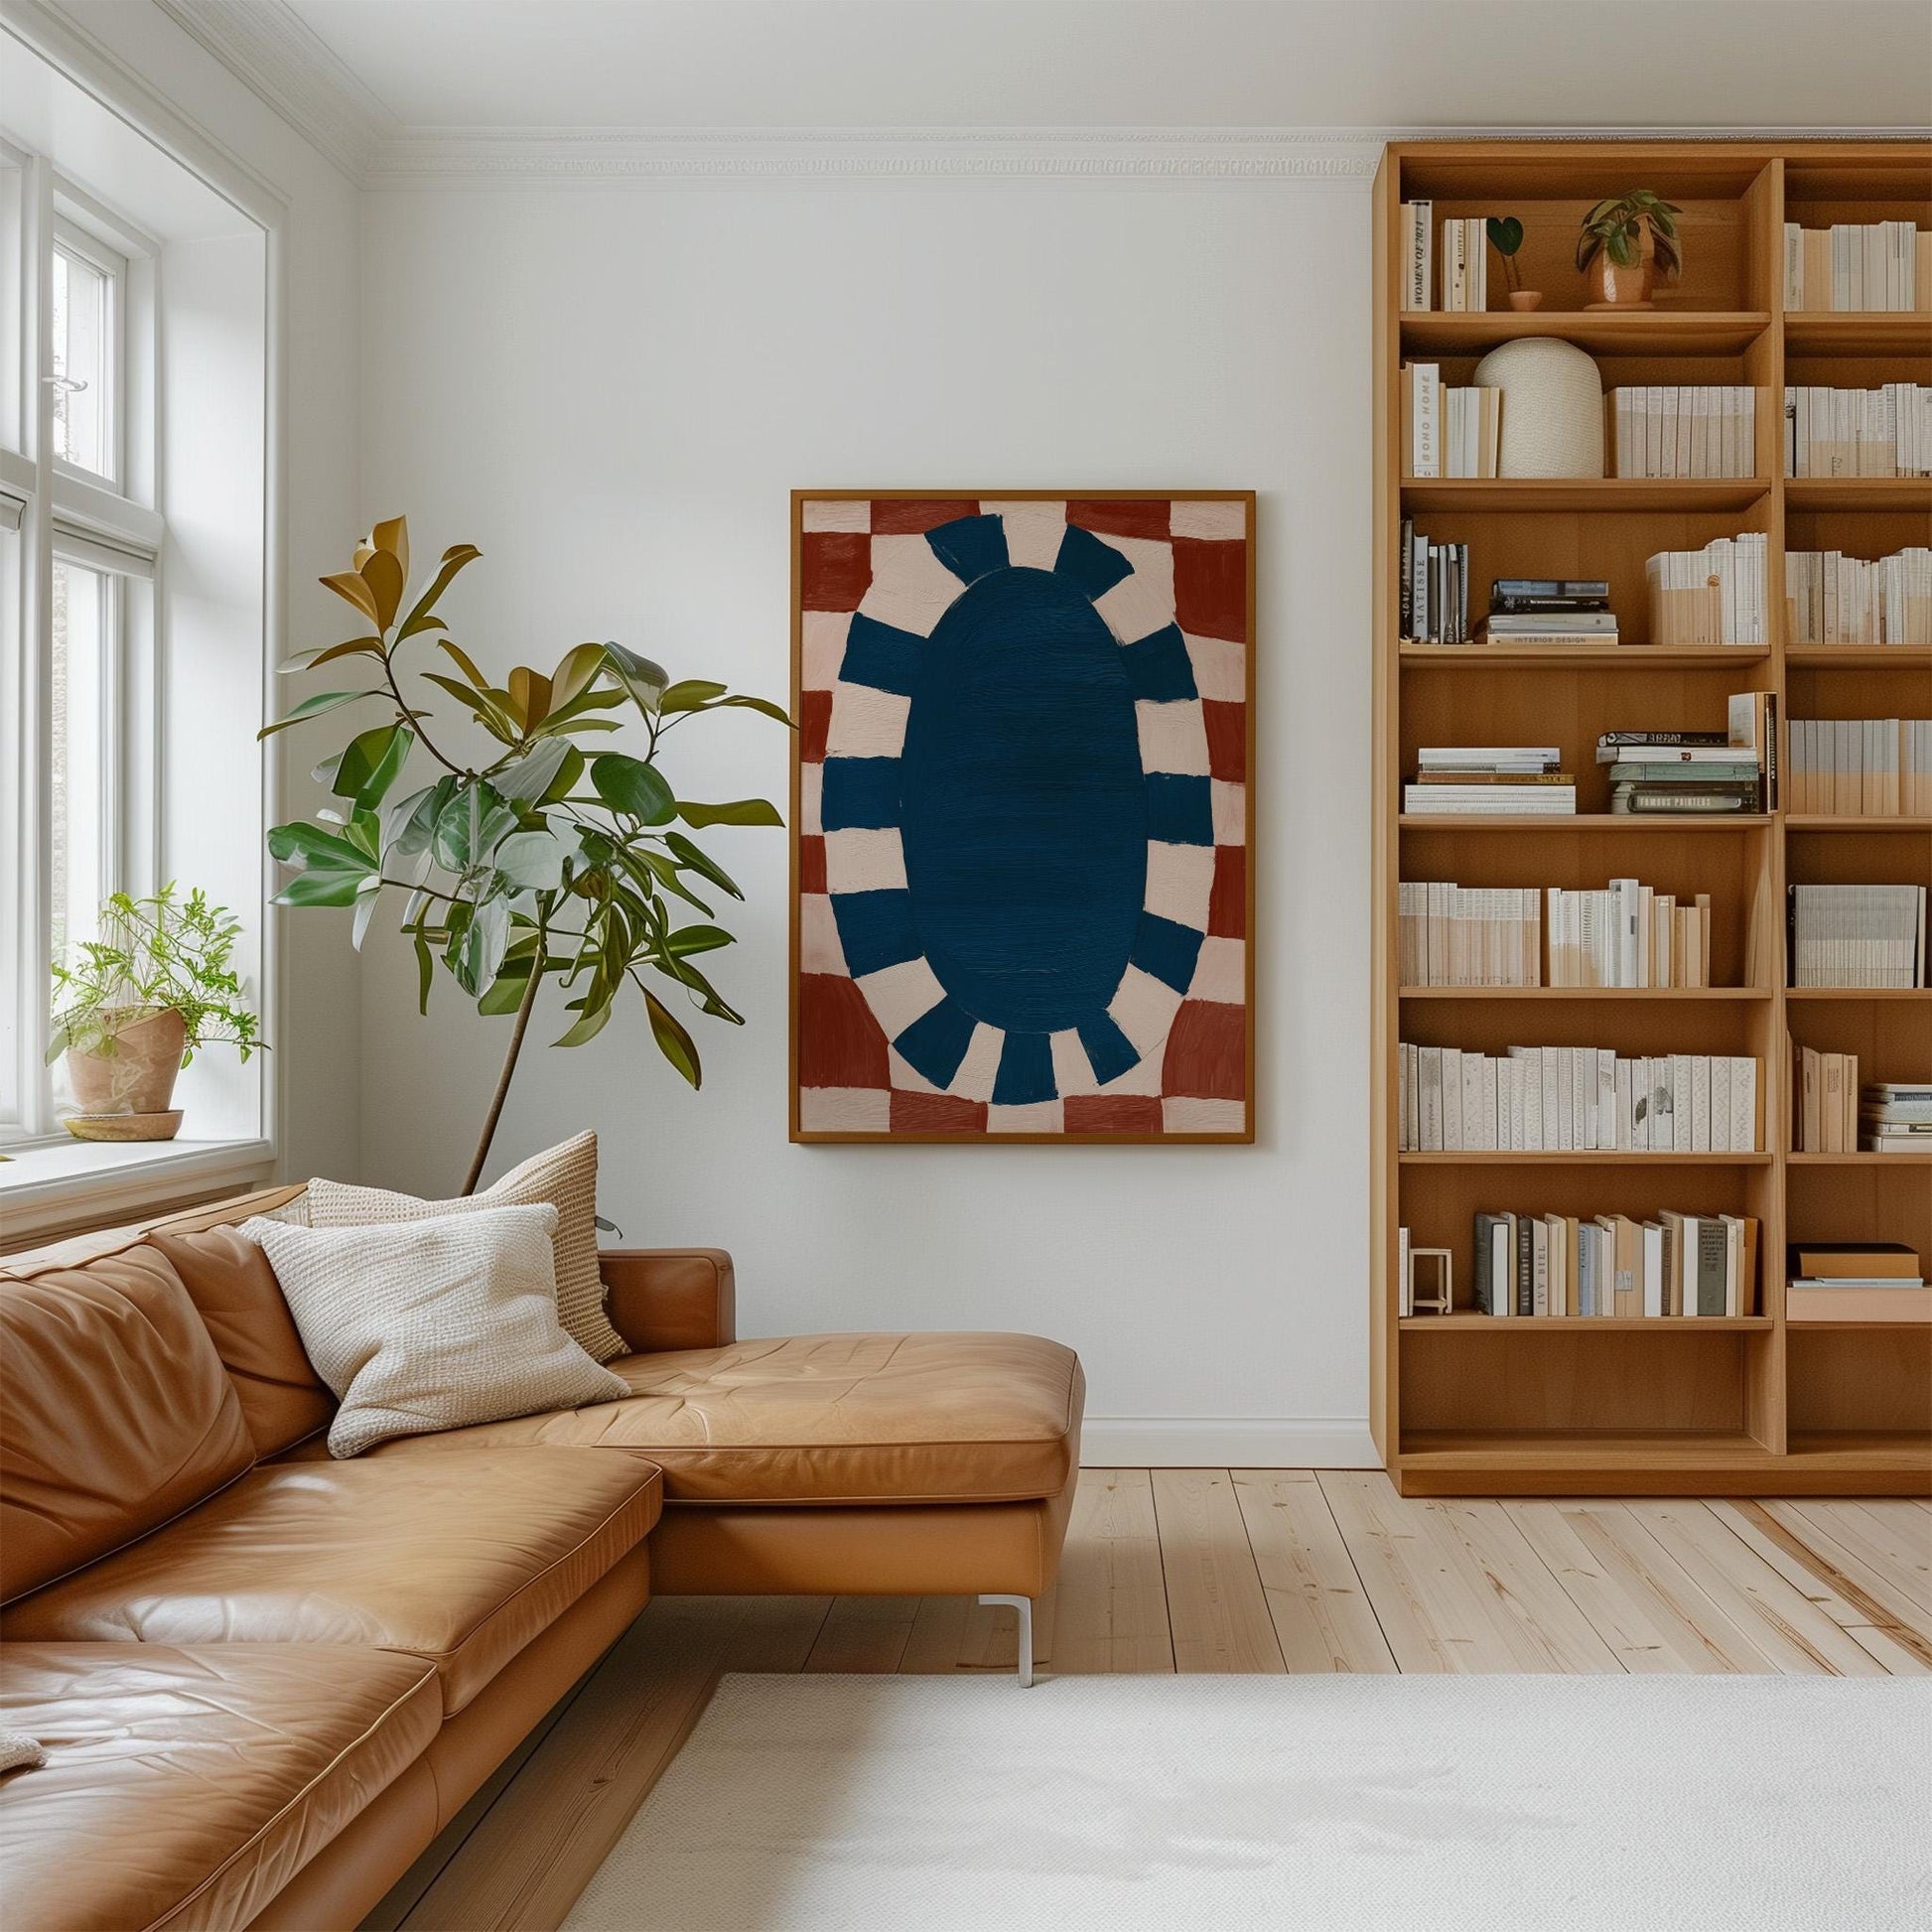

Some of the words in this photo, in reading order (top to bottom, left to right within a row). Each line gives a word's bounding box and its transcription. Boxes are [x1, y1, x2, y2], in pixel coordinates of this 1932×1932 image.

[1414, 244, 1424, 260] OF
[1414, 262, 1424, 305] WOMEN
[1422, 374, 1431, 415] HOME
[1422, 421, 1431, 462] BOHO
[1416, 559, 1425, 624] MATISSE
[1639, 797, 1671, 807] FAMOUS
[1674, 797, 1711, 807] PAINTERS
[1537, 1245, 1546, 1275] BIEL
[1537, 1282, 1546, 1305] IVY
